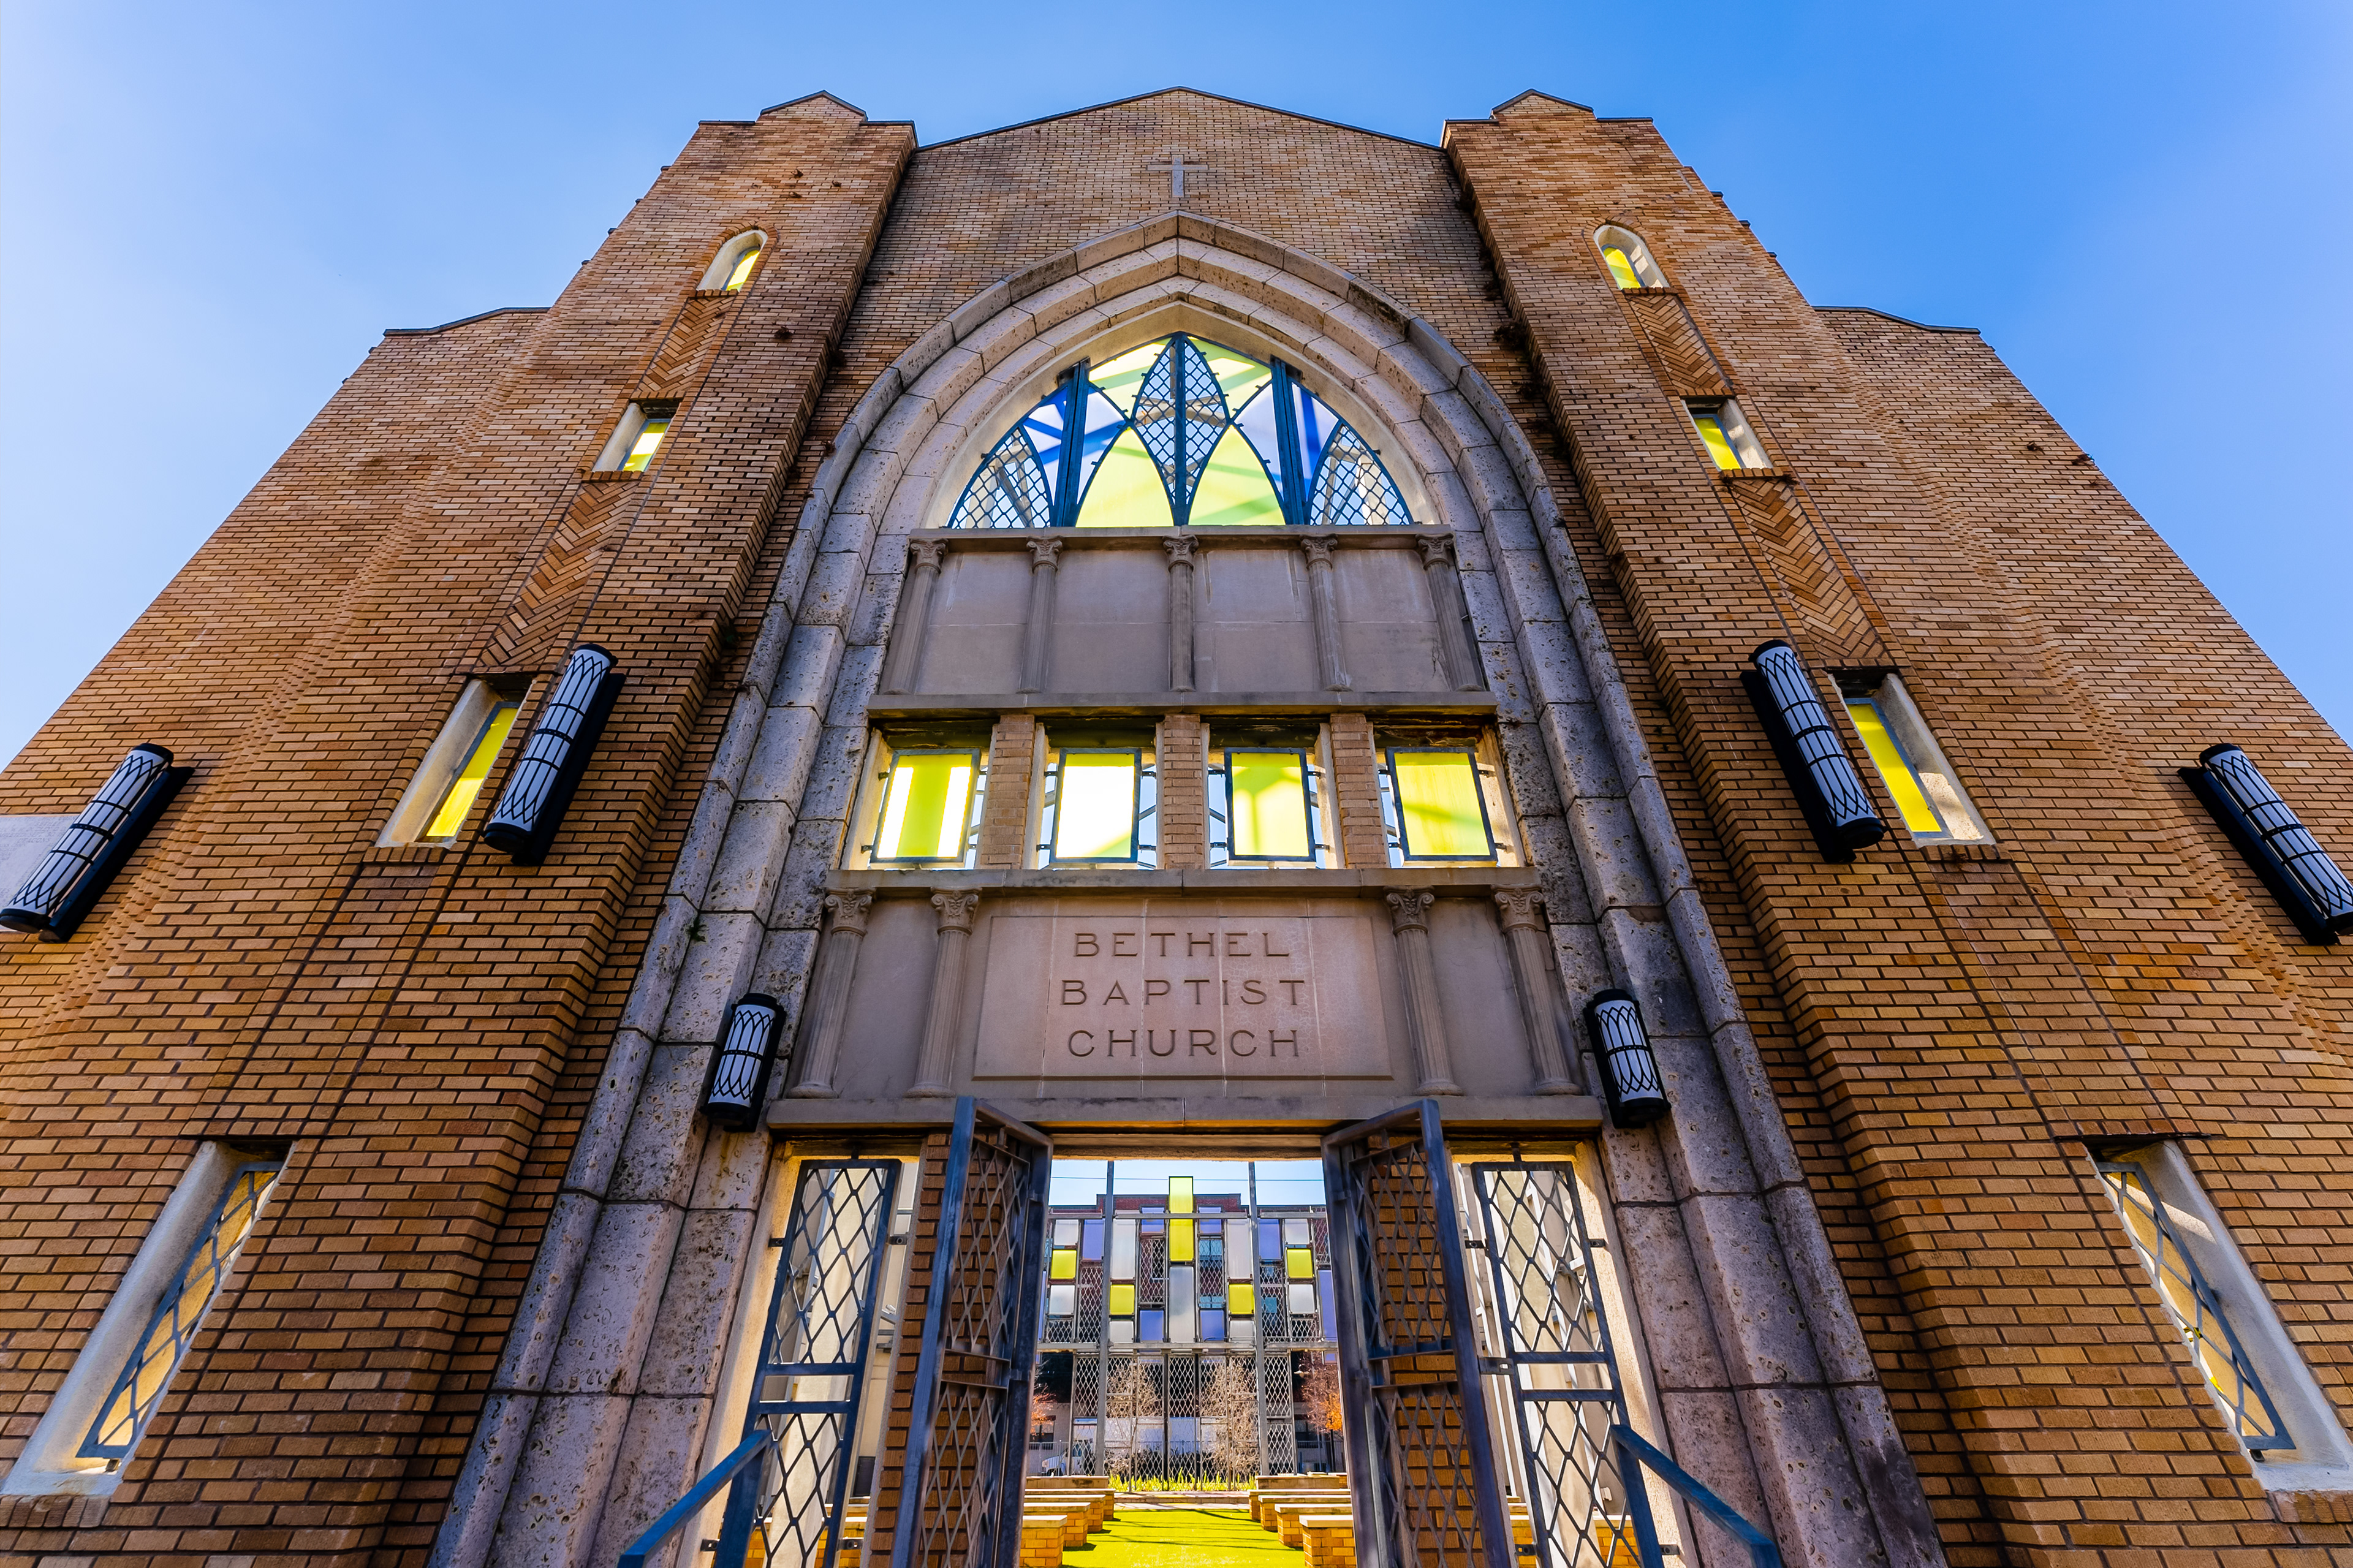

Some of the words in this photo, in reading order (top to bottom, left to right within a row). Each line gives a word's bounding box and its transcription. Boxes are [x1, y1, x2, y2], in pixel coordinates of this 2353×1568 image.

[1074, 933, 1290, 957] BETHEL
[1061, 979, 1305, 1006] BAPTIST
[1068, 1029, 1300, 1057] CHURCH
